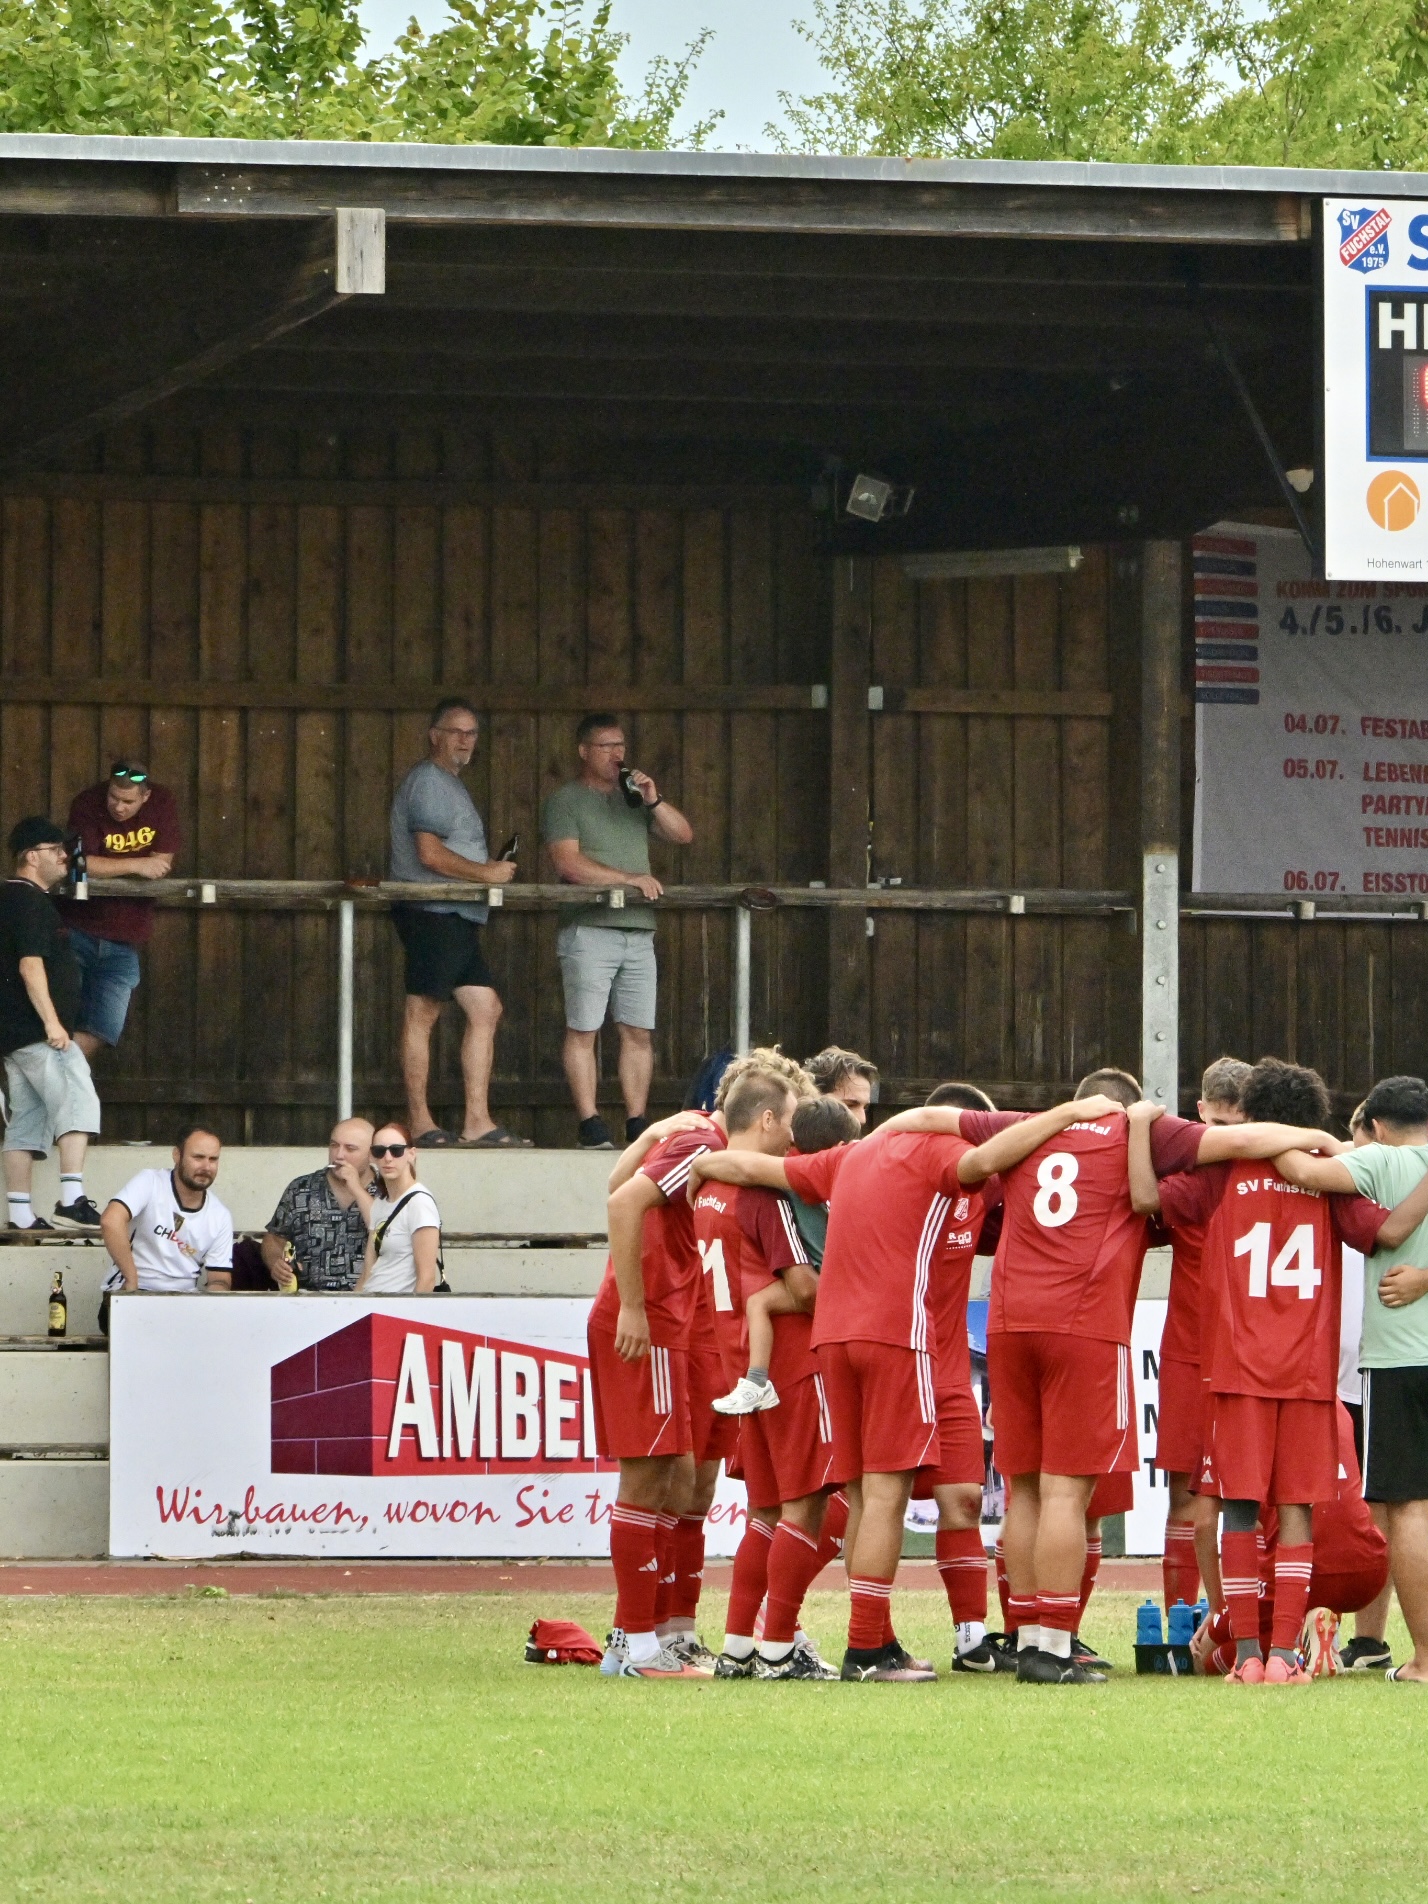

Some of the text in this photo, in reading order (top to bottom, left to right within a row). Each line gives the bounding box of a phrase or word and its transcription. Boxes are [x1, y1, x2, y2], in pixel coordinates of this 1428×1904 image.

[1342, 210, 1360, 230] SV
[1340, 210, 1391, 261] FUCHSTAL
[1369, 243, 1385, 254] e.V.
[1362, 256, 1384, 268] 1975
[1367, 558, 1423, 569] Hohenwart
[1284, 713, 1347, 736] 04.07.
[1283, 758, 1345, 781] 05.07.
[104, 826, 154, 852] 1946
[1283, 870, 1347, 893] 06.07.
[1033, 1151, 1079, 1228] 8
[1237, 1178, 1259, 1195] SV
[1234, 1221, 1322, 1300] 14
[156, 1484, 225, 1526] Wir
[236, 1485, 370, 1532] bauen,
[384, 1499, 501, 1526] wovon
[515, 1485, 574, 1528] Sie
